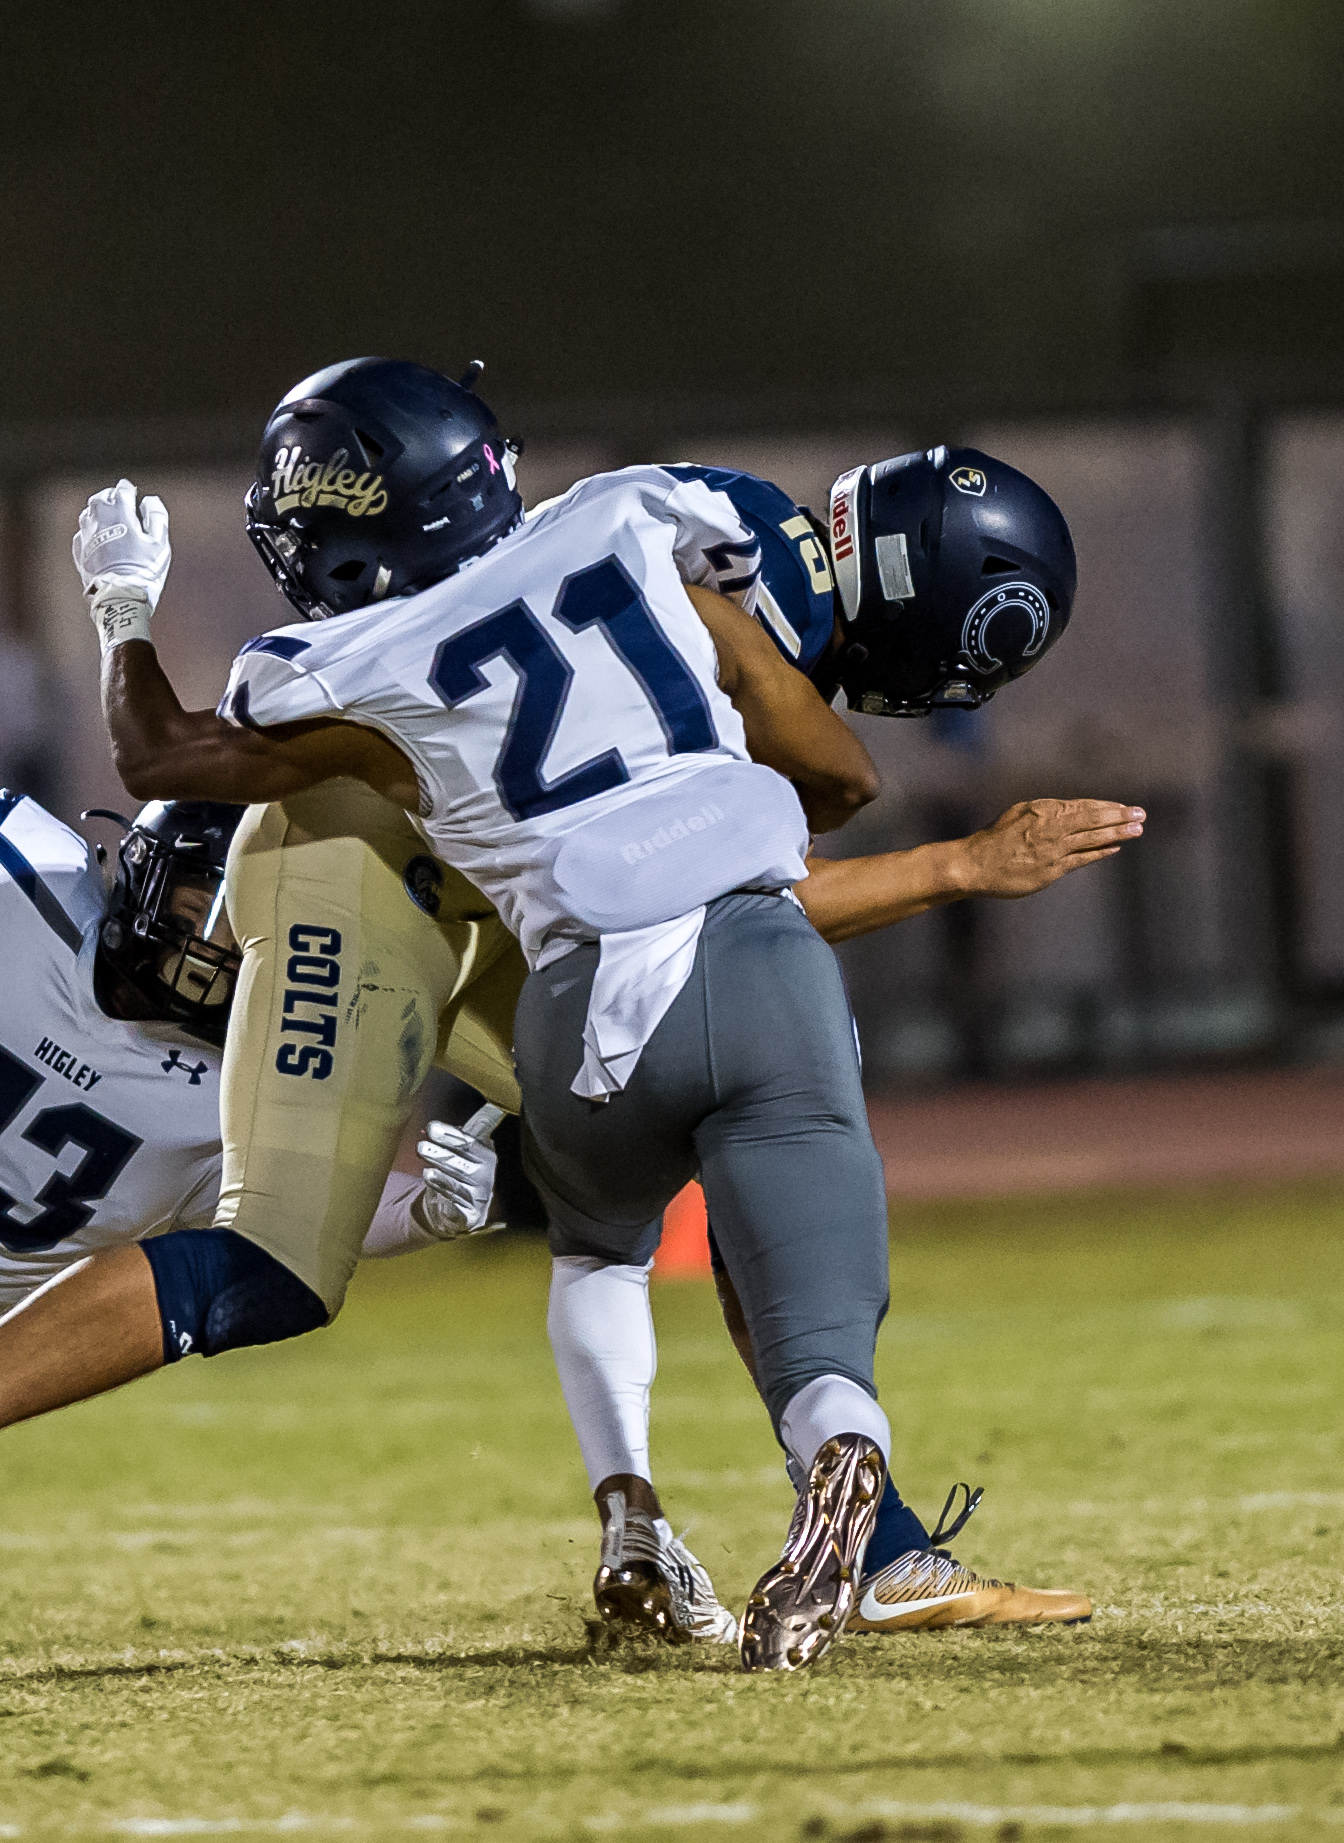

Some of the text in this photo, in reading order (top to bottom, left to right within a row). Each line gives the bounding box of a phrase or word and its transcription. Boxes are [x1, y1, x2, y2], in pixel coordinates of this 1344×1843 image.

[271, 446, 388, 517] Higley
[426, 553, 721, 824] 21
[275, 923, 342, 1081] COLTS
[33, 1036, 102, 1092] HIGLEY
